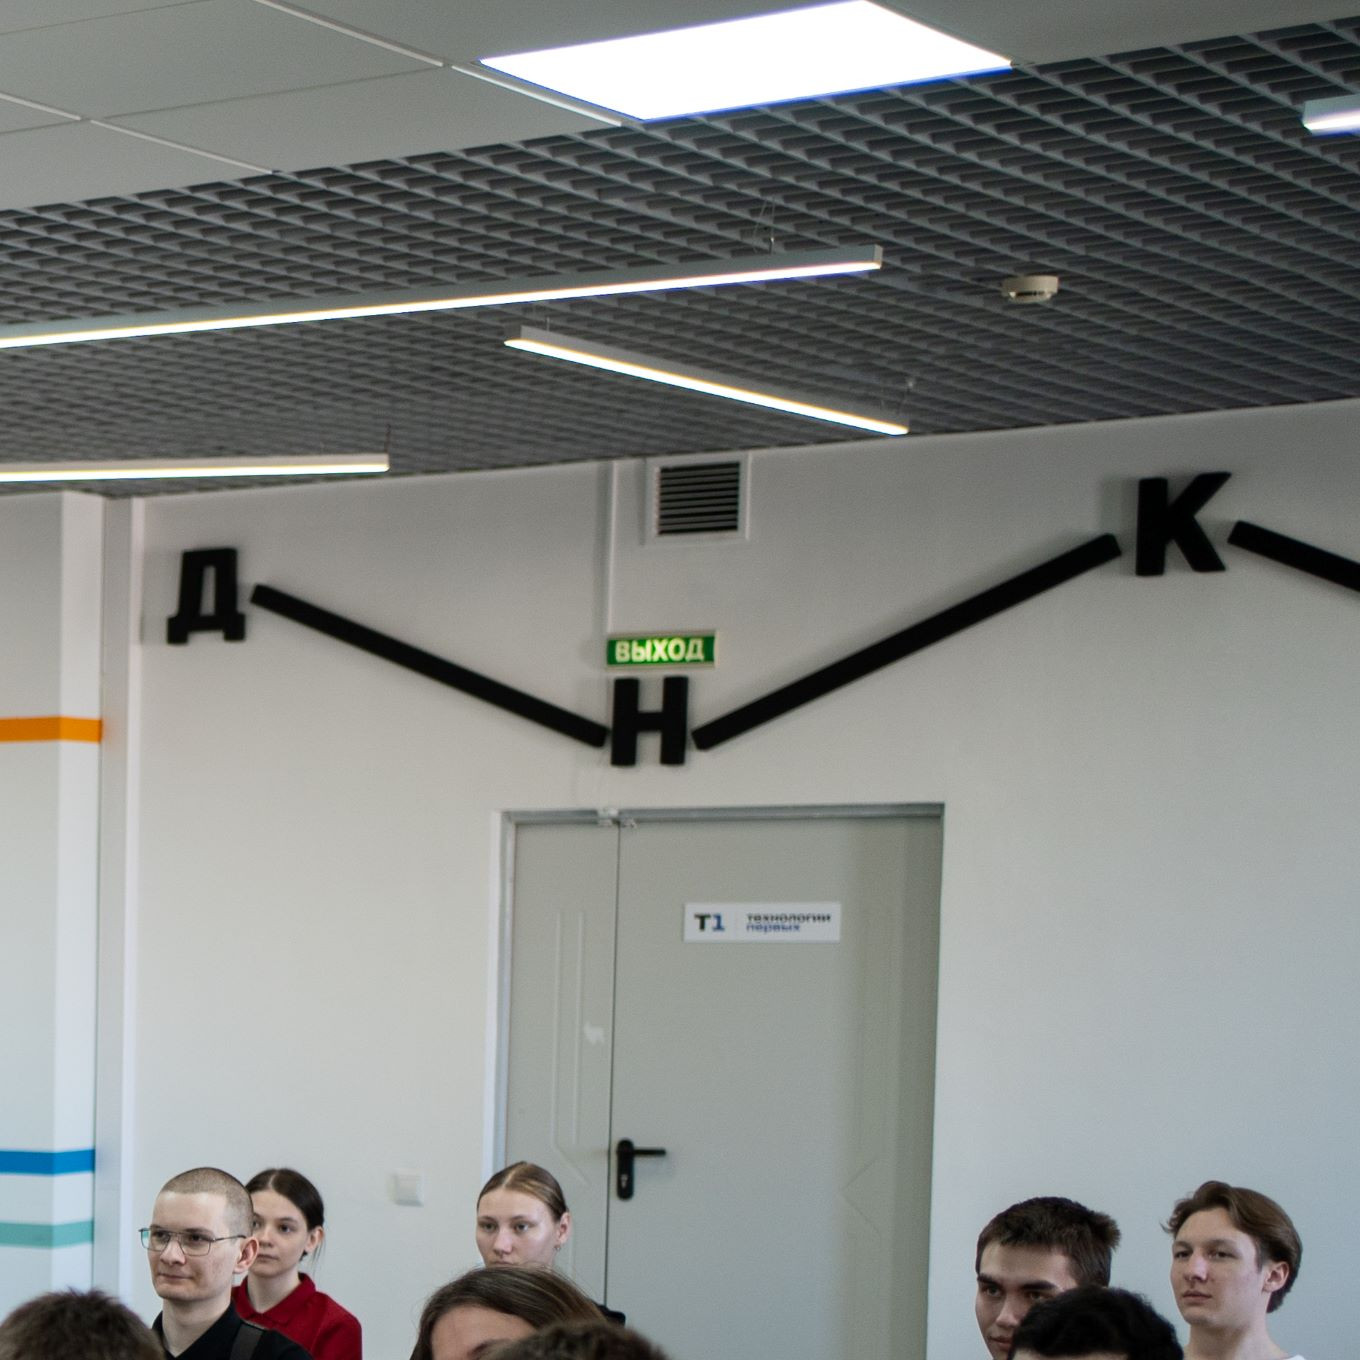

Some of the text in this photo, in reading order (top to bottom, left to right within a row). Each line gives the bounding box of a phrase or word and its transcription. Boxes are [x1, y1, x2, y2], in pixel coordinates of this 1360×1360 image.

[166, 470, 1233, 767] Д Н К
[615, 638, 704, 662] ВЫХОД
